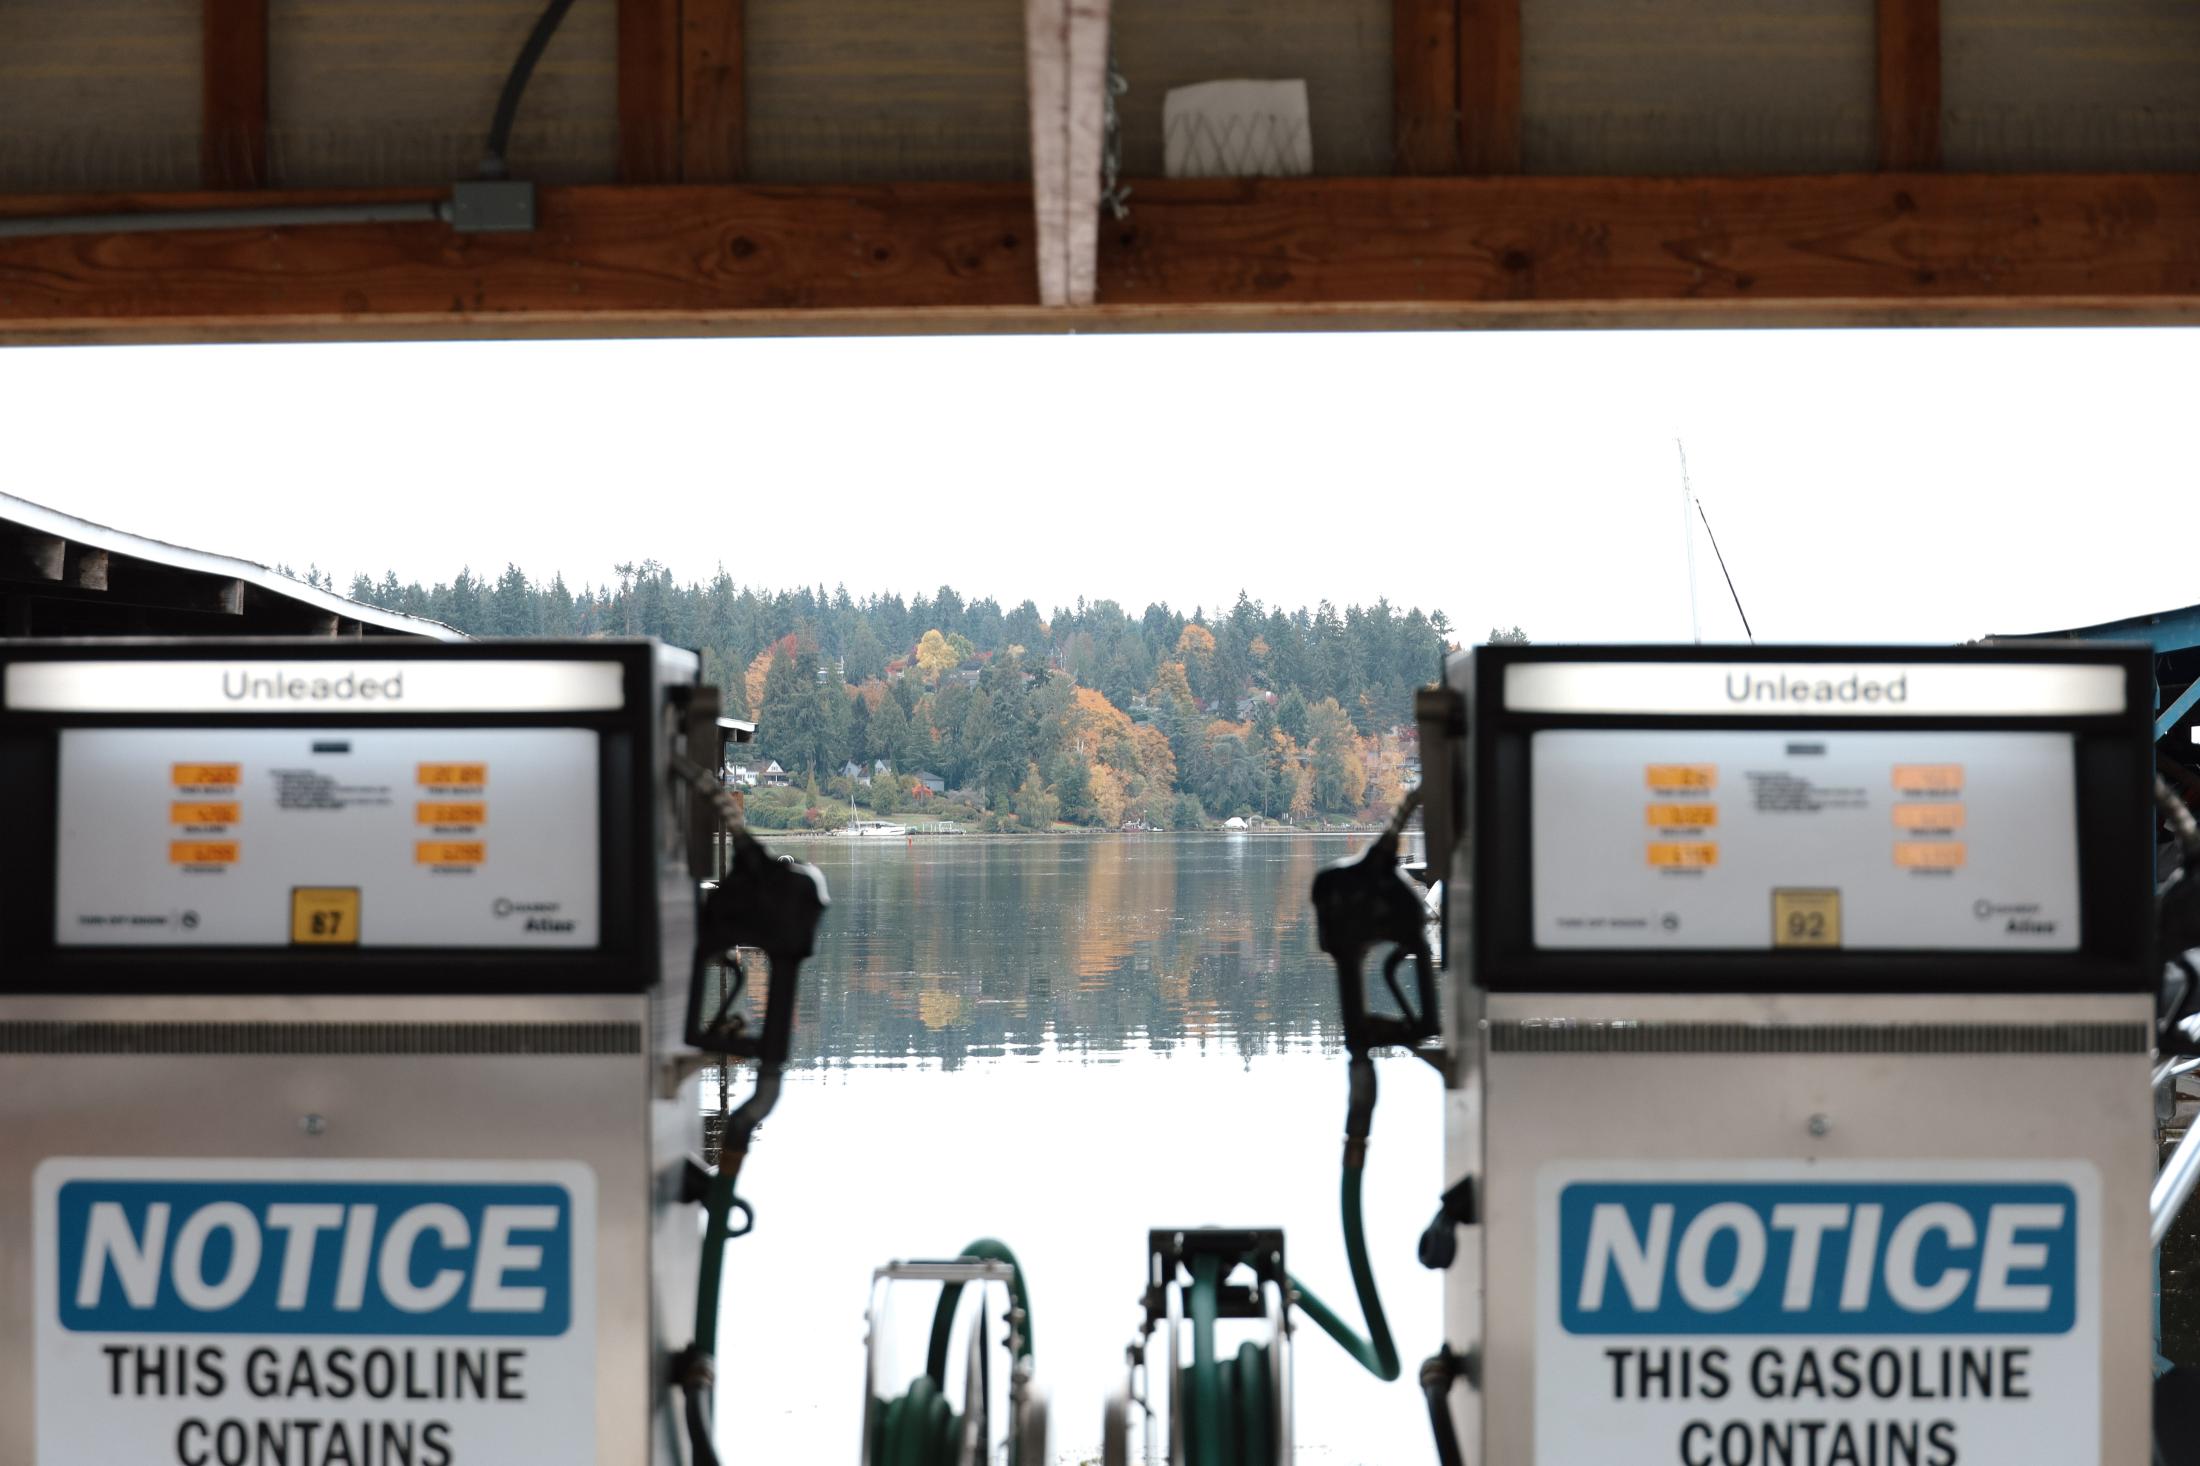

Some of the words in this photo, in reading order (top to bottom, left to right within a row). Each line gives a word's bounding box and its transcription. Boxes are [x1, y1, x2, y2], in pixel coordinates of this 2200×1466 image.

[222, 671, 404, 701] Unleaded
[1725, 673, 1908, 703] Unleaded
[311, 911, 342, 935] 87
[1788, 912, 1825, 938] 92
[75, 1201, 560, 1314] NOTICE
[1577, 1202, 2066, 1313] NOTICE
[103, 1346, 226, 1396] THIS
[245, 1347, 526, 1400] GASOLINE
[1605, 1348, 1730, 1398] THIS
[1750, 1347, 2031, 1399] GASOLINE
[177, 1418, 453, 1466] CONTAINS
[1680, 1420, 1957, 1466] CONTAINS
